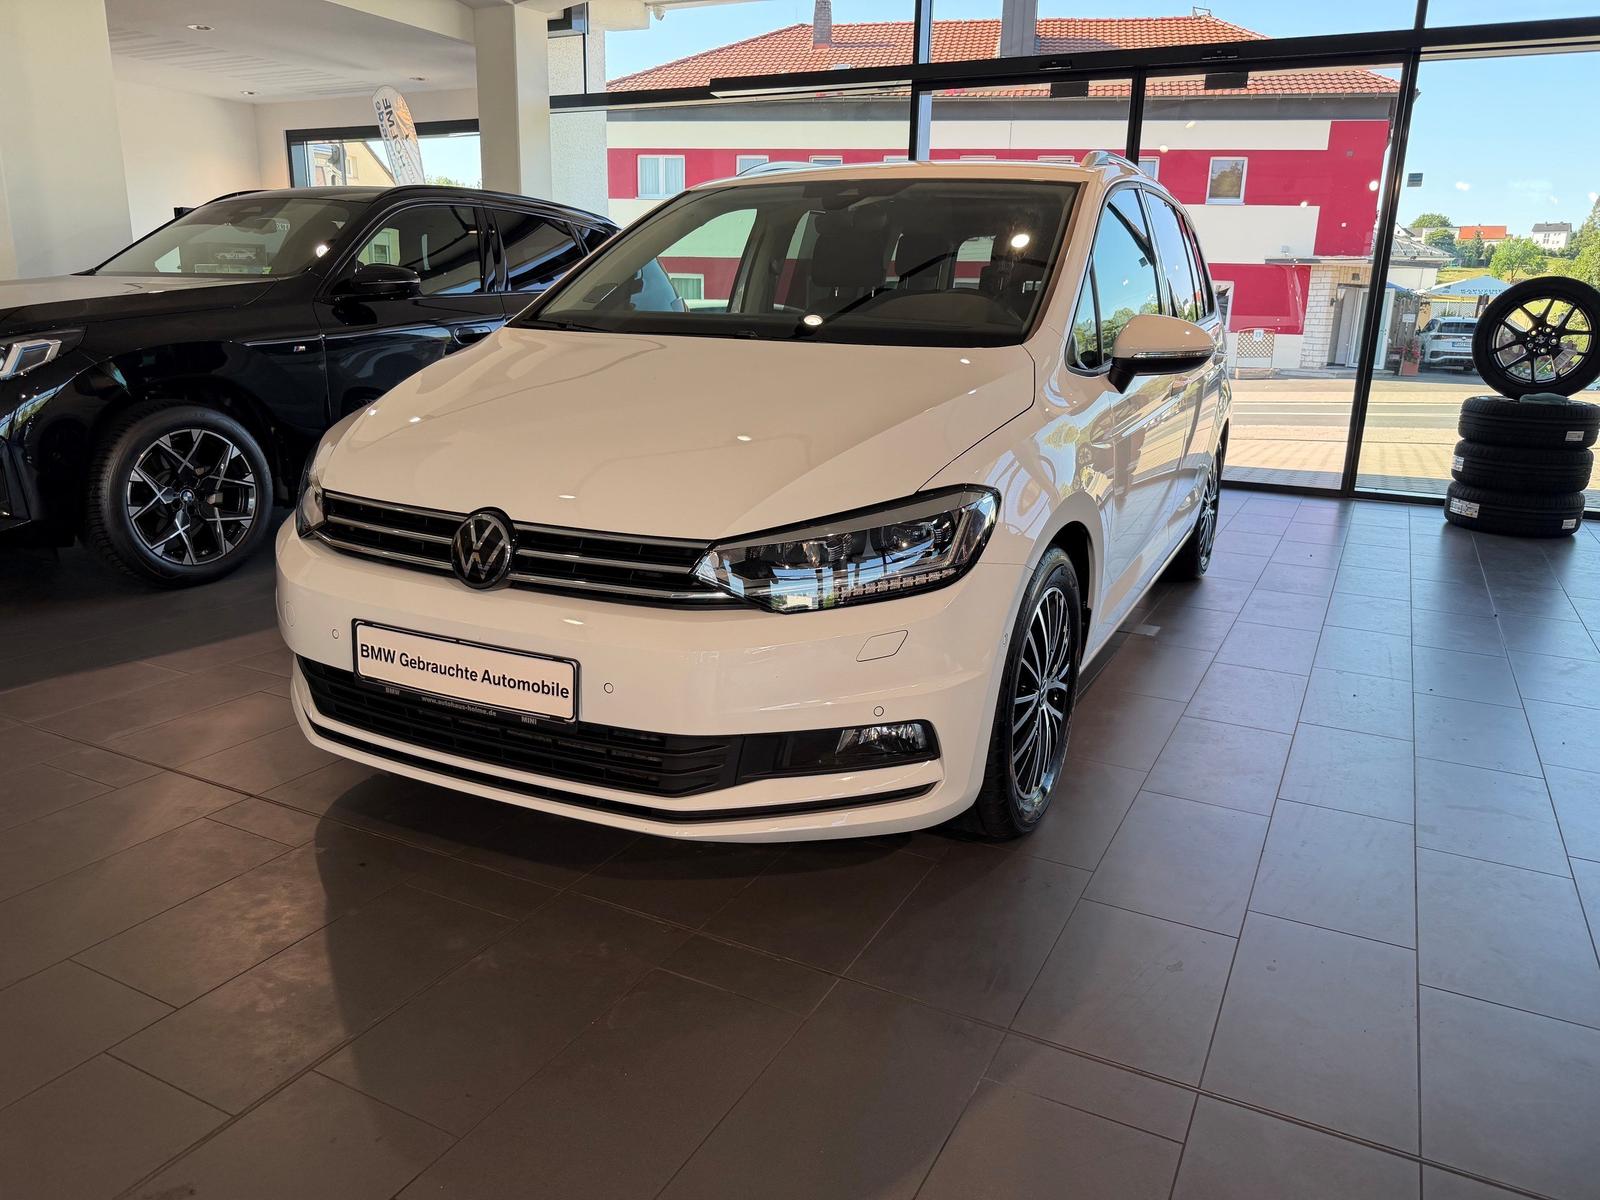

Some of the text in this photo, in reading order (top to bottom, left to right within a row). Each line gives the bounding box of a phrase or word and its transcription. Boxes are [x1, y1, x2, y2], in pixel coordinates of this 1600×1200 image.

[360, 643, 570, 699] BMW Gebrauchte Automobile
[385, 687, 400, 696] BMW
[521, 716, 537, 726] MINI
